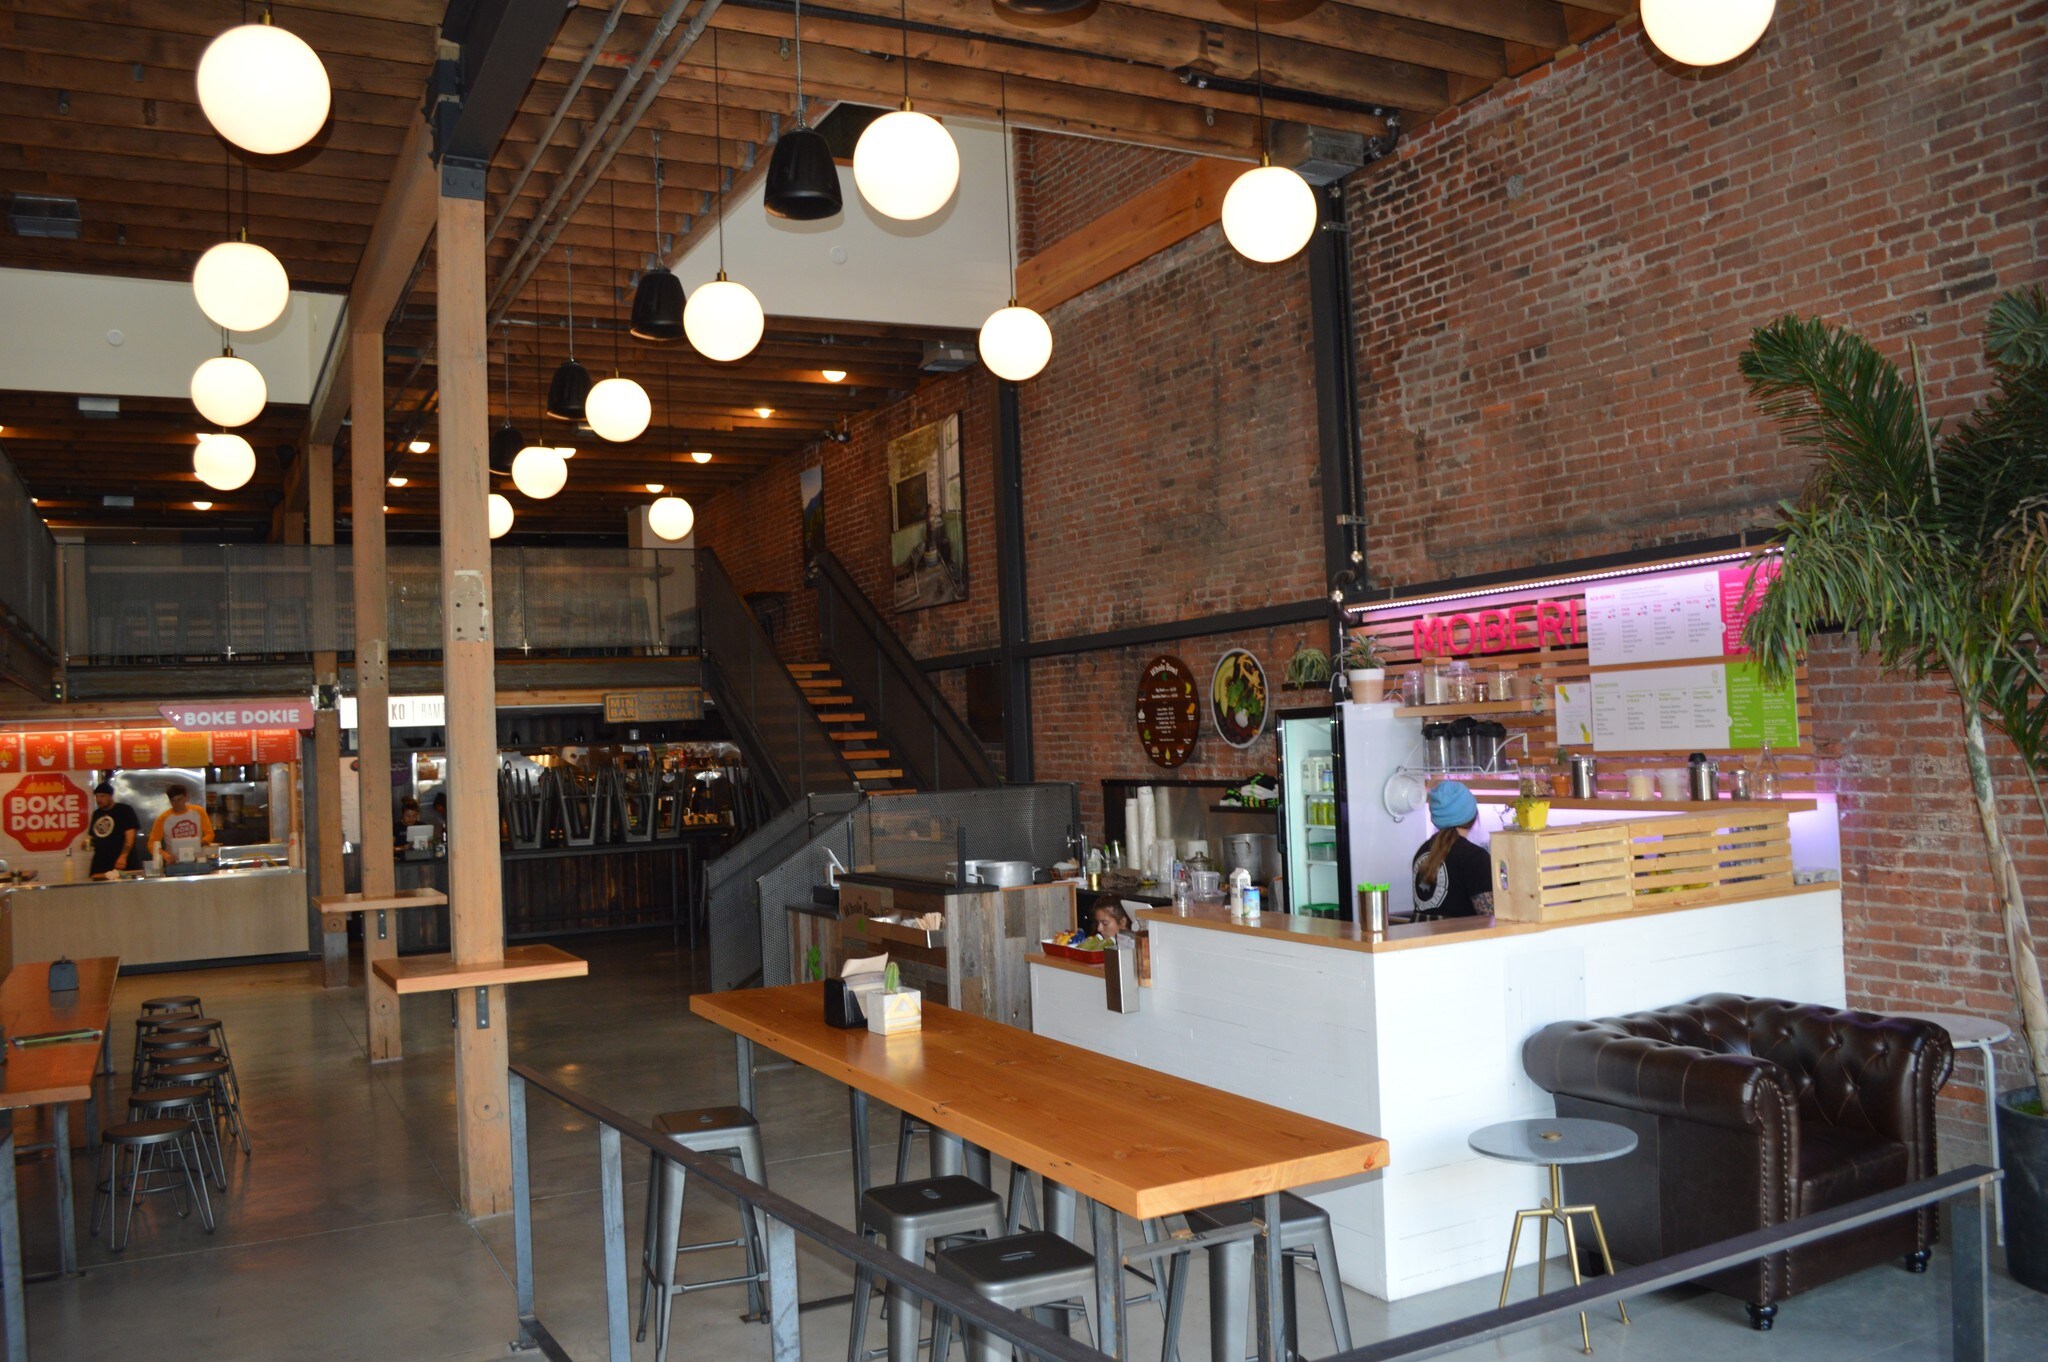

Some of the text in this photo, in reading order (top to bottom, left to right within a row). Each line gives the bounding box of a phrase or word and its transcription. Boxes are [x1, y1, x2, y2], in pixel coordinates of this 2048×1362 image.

[1412, 598, 1580, 660] MOBERI
[184, 709, 300, 726] BOKE DOKIE
[610, 709, 634, 717] BAR
[11, 794, 80, 814] BOKE
[11, 813, 80, 831] DOKIE
